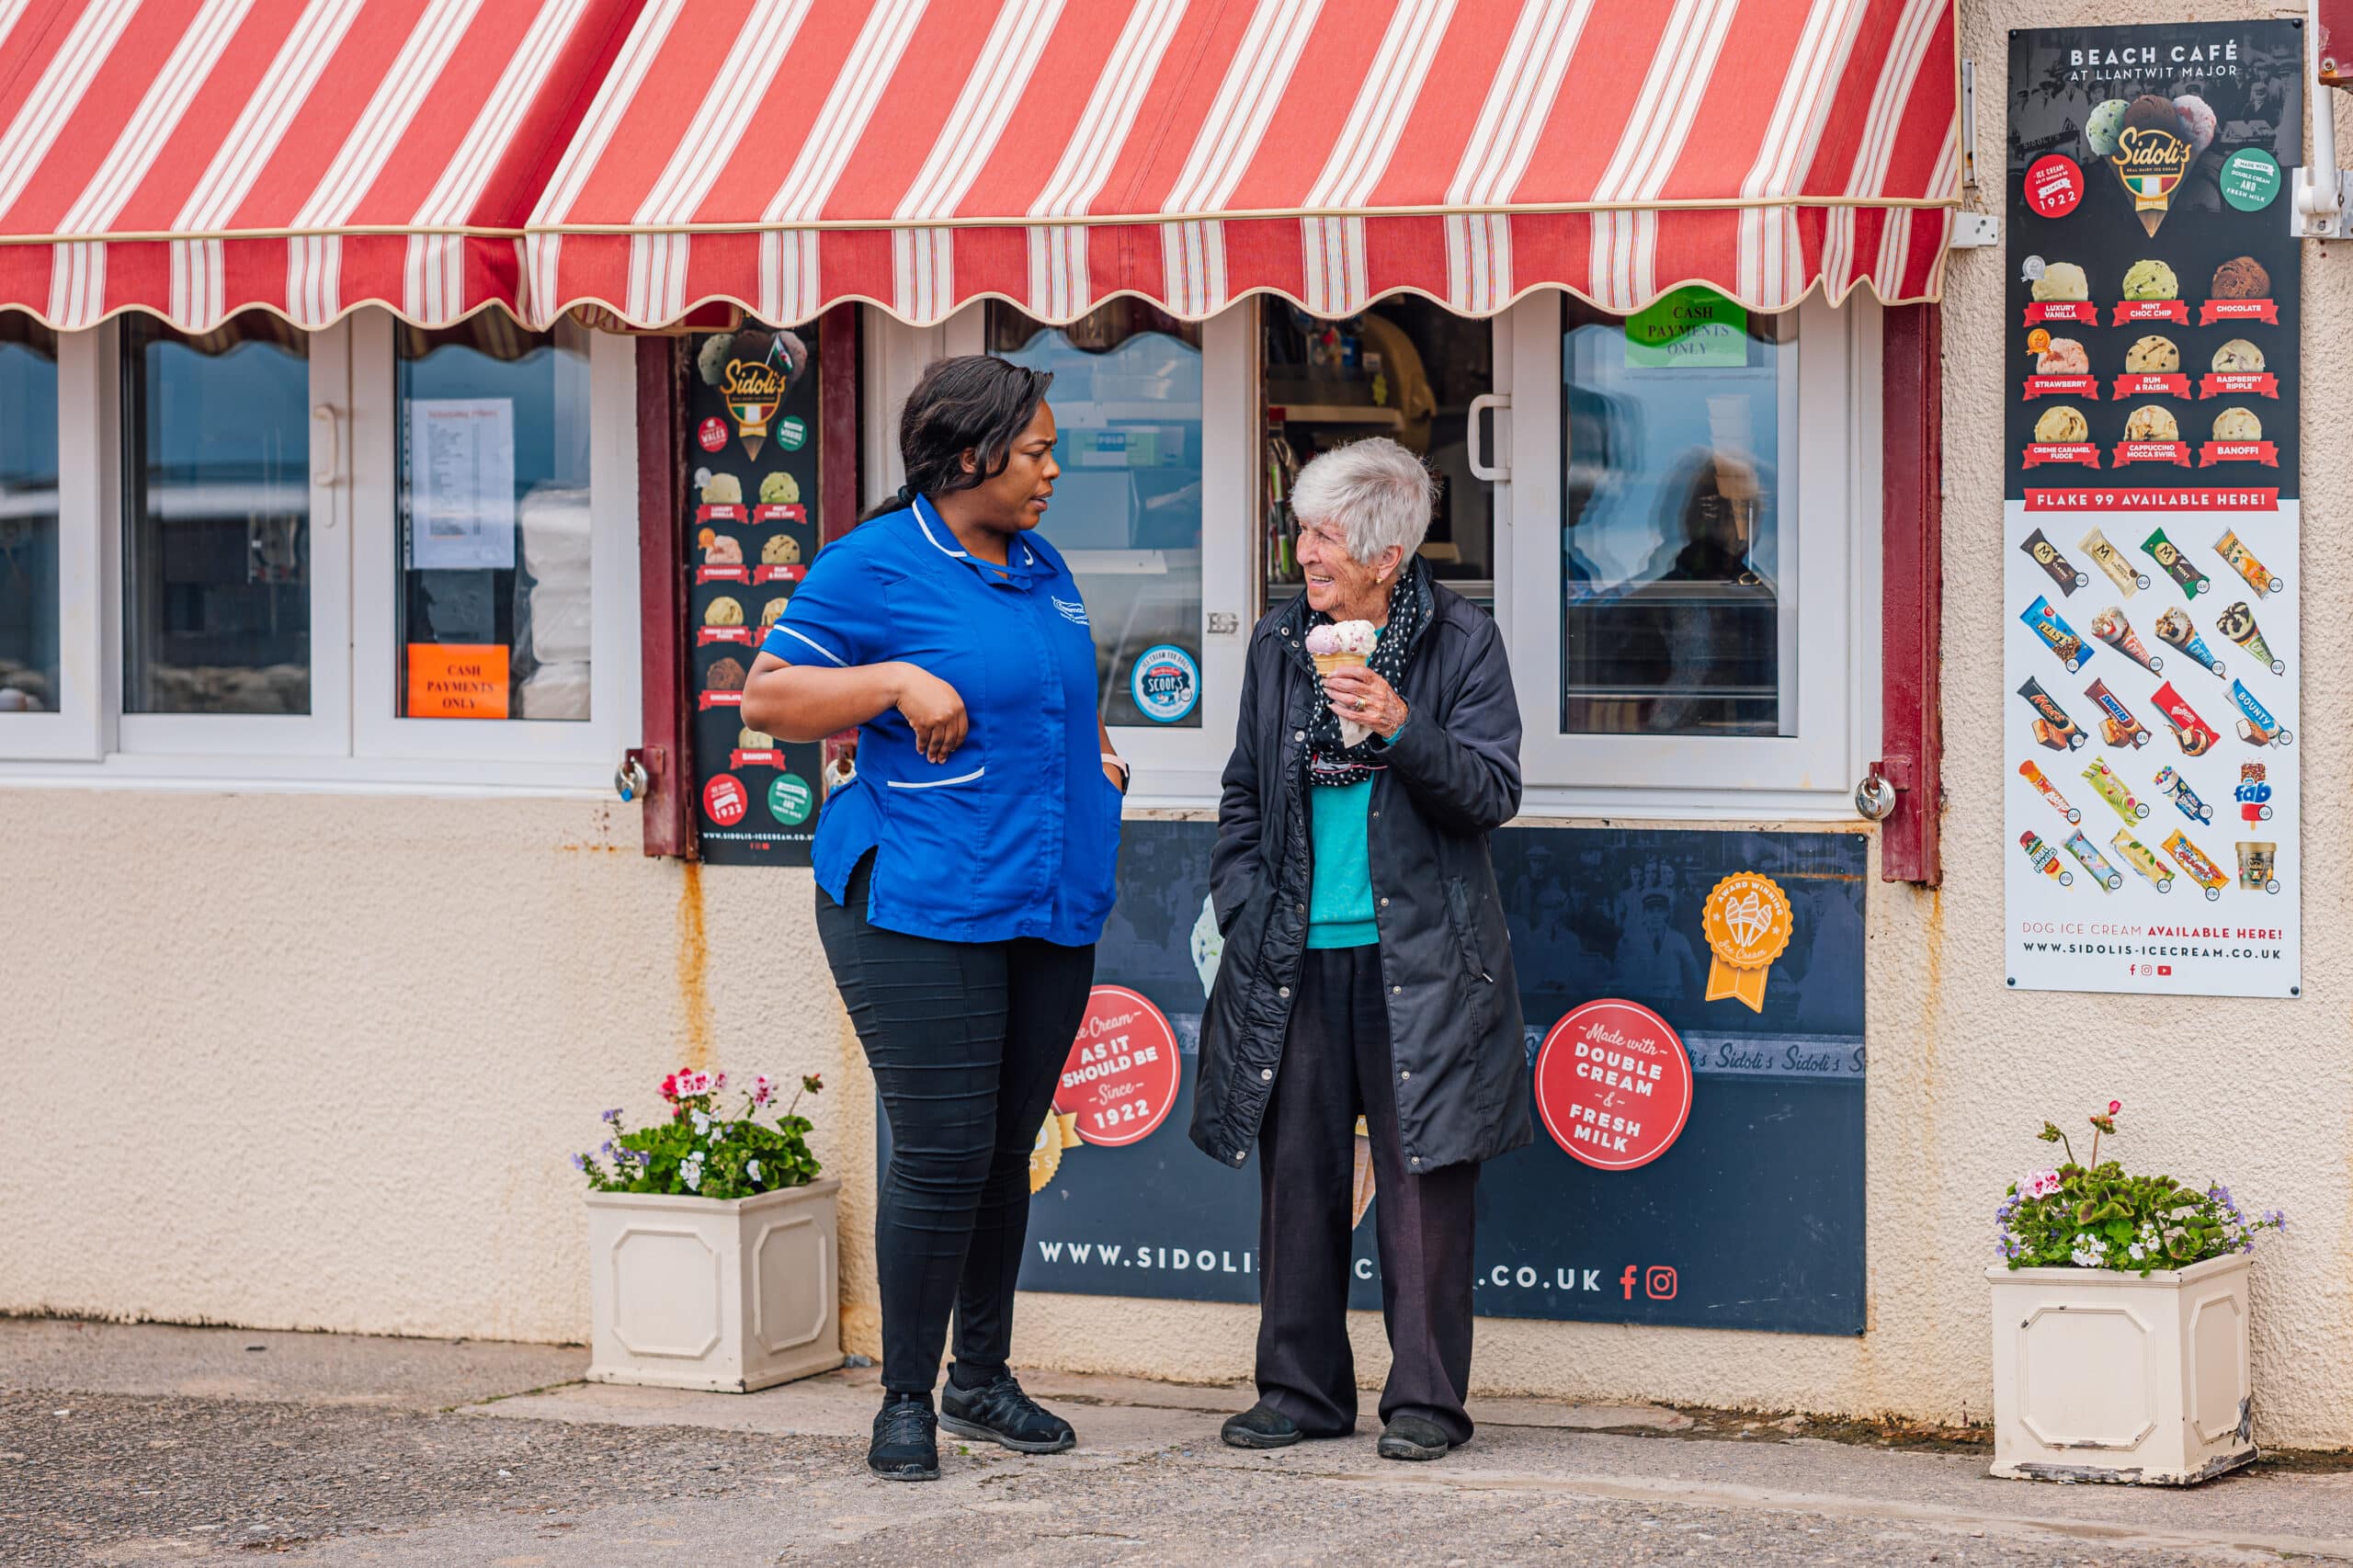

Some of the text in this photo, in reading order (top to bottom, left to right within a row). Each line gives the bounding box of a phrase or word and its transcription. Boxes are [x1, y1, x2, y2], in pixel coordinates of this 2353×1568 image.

[2071, 40, 2237, 66] BEACH CAFÉ
[2070, 65, 2237, 82] AT LLANTWIT MAJOR
[2112, 126, 2192, 165] Sidoli's
[2036, 164, 2064, 178] ICE CREAM
[2227, 187, 2265, 203] FRESH MILK
[2240, 180, 2256, 192] AND
[2040, 191, 2075, 210] 1922
[1673, 306, 1713, 319] CASH
[1648, 324, 1729, 337] PAYMENTS
[1667, 343, 1706, 355] ONLY
[720, 358, 787, 394] Sidoli's
[2217, 446, 2259, 454] BANOFFI
[2037, 494, 2265, 506] FLAKE 99 AVAILABLE HERE!
[2052, 562, 2068, 579] CLASSIC
[2177, 564, 2191, 579] MINT
[2037, 621, 2069, 646] FEAST
[447, 665, 481, 676] CASH
[427, 681, 494, 693] PAYMENTS
[1148, 676, 1183, 692] SCOOPS
[442, 698, 476, 710] ONLY
[2101, 695, 2129, 722] SNICKERS
[2238, 692, 2271, 725] BOUNTY
[2235, 782, 2272, 803] fab
[715, 803, 742, 819] 1922
[1718, 881, 1783, 916] AWARD WINNING
[2023, 922, 2282, 939] DOG ICE CREAM AVAILABLE HERE!
[1719, 939, 1766, 960] Ice Cream
[2023, 943, 2280, 959] WWW.SIDOLIS-ICECREAM.CO.UK
[1075, 1014, 1133, 1040] ce Cream
[1586, 1023, 1657, 1056] Made with
[1081, 1035, 1129, 1064] AS IT
[1062, 1046, 1159, 1088] SHOULD BE
[1575, 1042, 1662, 1080] DOUBLE
[1576, 1062, 1653, 1096] CREAM
[1098, 1082, 1135, 1106] Since
[1603, 1091, 1615, 1108] &
[1094, 1099, 1150, 1129] 1922
[1569, 1103, 1641, 1137] FRESH
[1574, 1125, 1628, 1153] MILK
